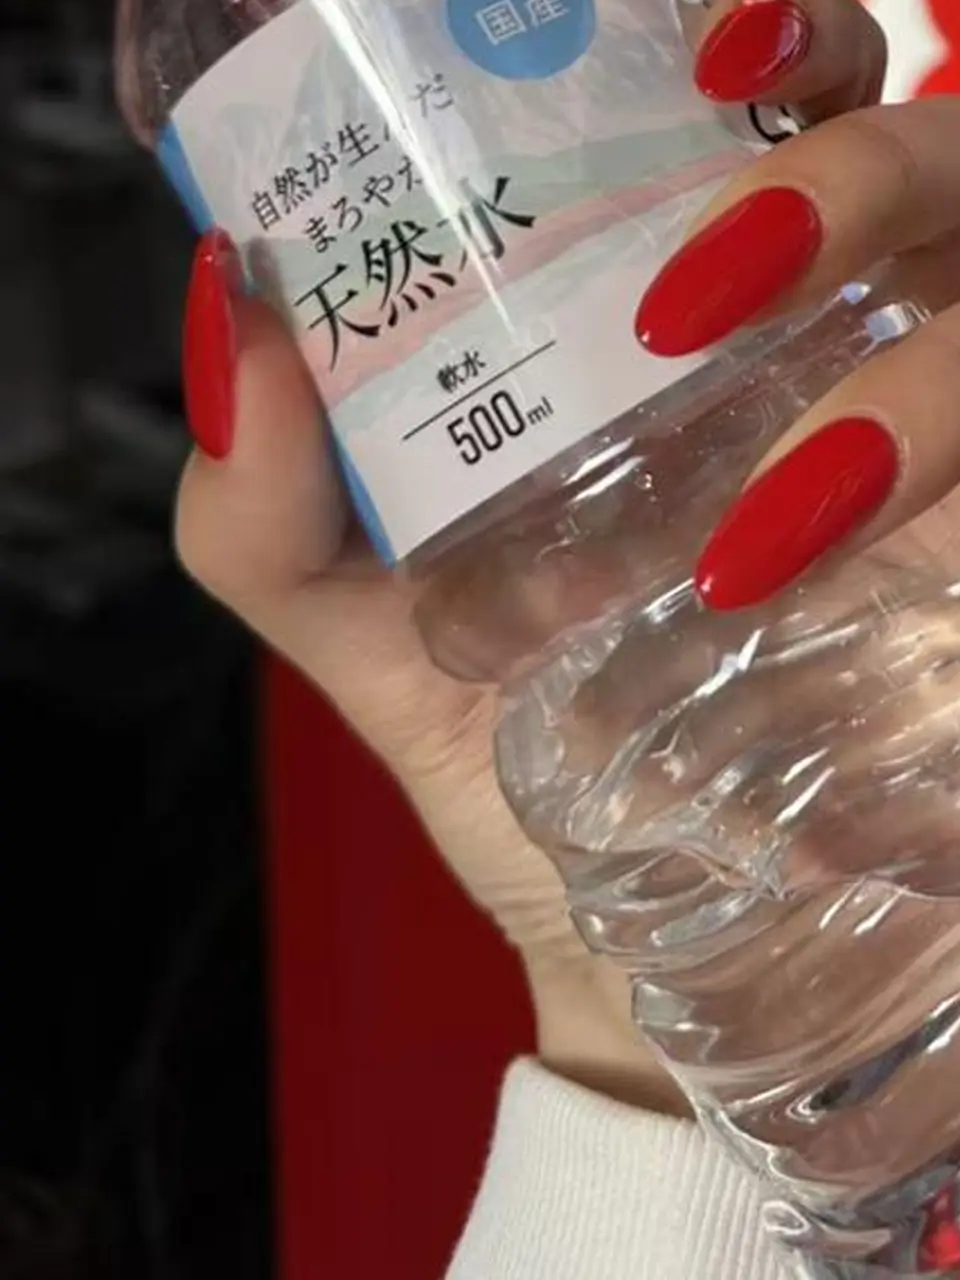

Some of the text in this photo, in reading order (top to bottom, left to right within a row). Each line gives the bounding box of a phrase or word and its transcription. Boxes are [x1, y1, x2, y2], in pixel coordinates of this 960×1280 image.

[251, 73, 454, 231] 自然が生だ
